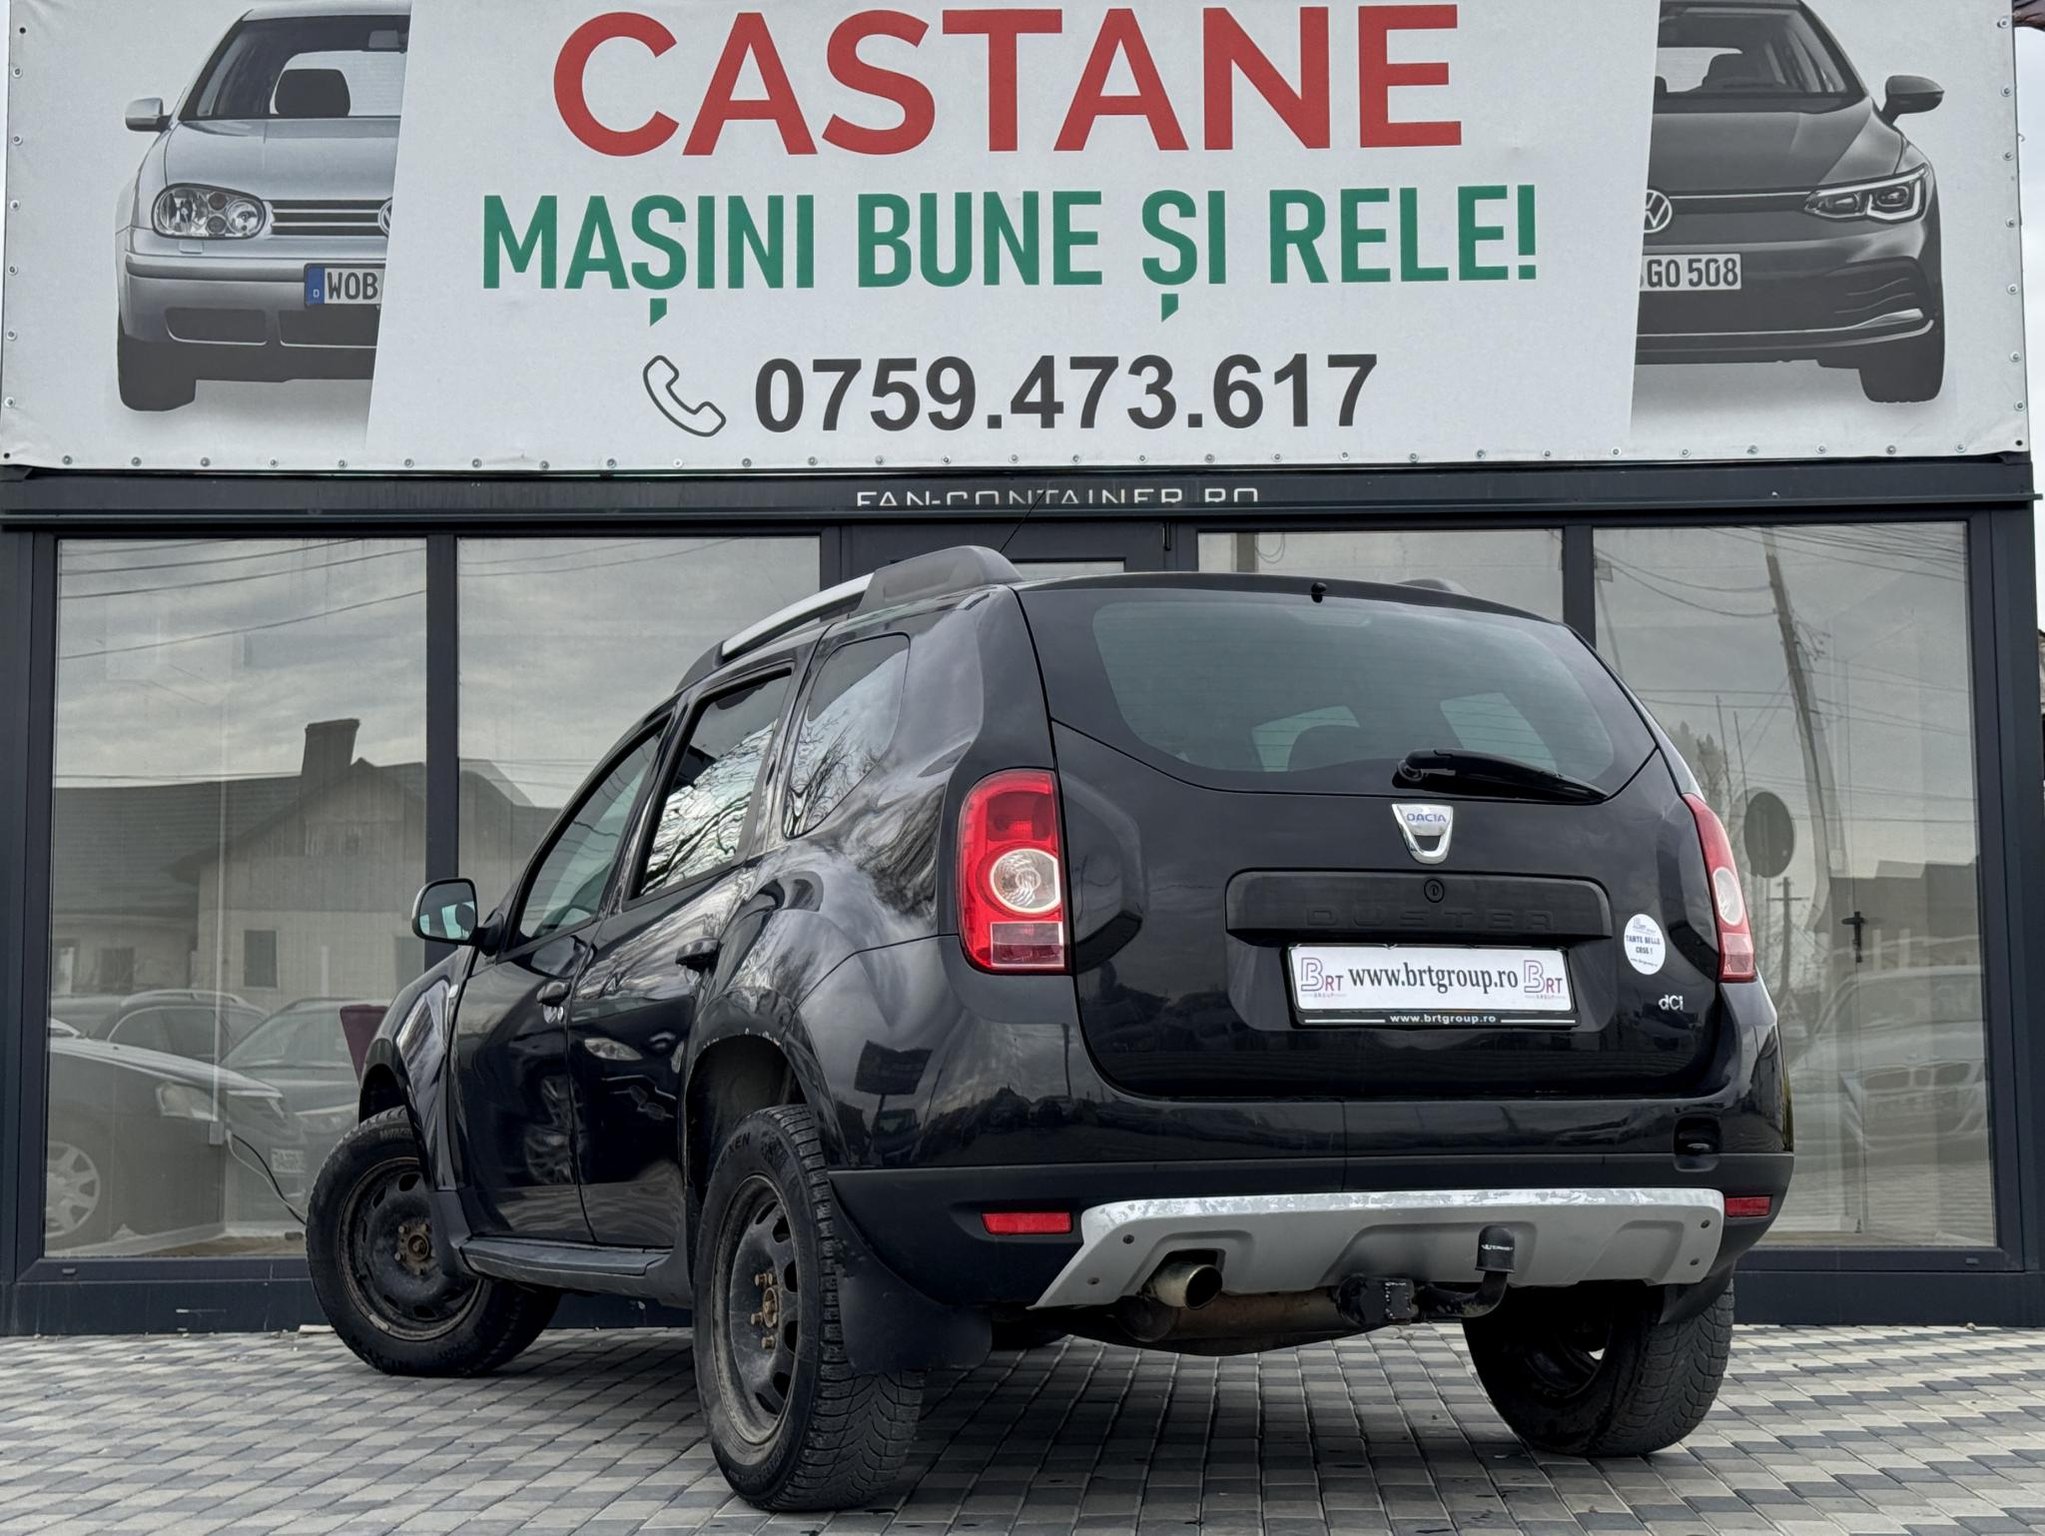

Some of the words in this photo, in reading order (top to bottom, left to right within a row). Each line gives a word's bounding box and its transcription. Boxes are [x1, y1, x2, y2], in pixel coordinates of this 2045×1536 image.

[553, 5, 1461, 156] CASTANE
[483, 195, 814, 326] MAȘINI
[858, 191, 1102, 287] BUNE
[1142, 190, 1226, 323] ȘI
[1269, 184, 1536, 283] RELE!
[313, 288, 320, 298] D
[327, 272, 378, 300] WOB
[1687, 257, 1739, 287] 508
[755, 352, 1377, 433] 0759.473.617
[1406, 812, 1447, 823] DACIA
[1306, 906, 1552, 931] DUSTER
[1348, 962, 1518, 994] www.brtgroup.ro
[1389, 1014, 1496, 1025] www.brtgroup.ro
